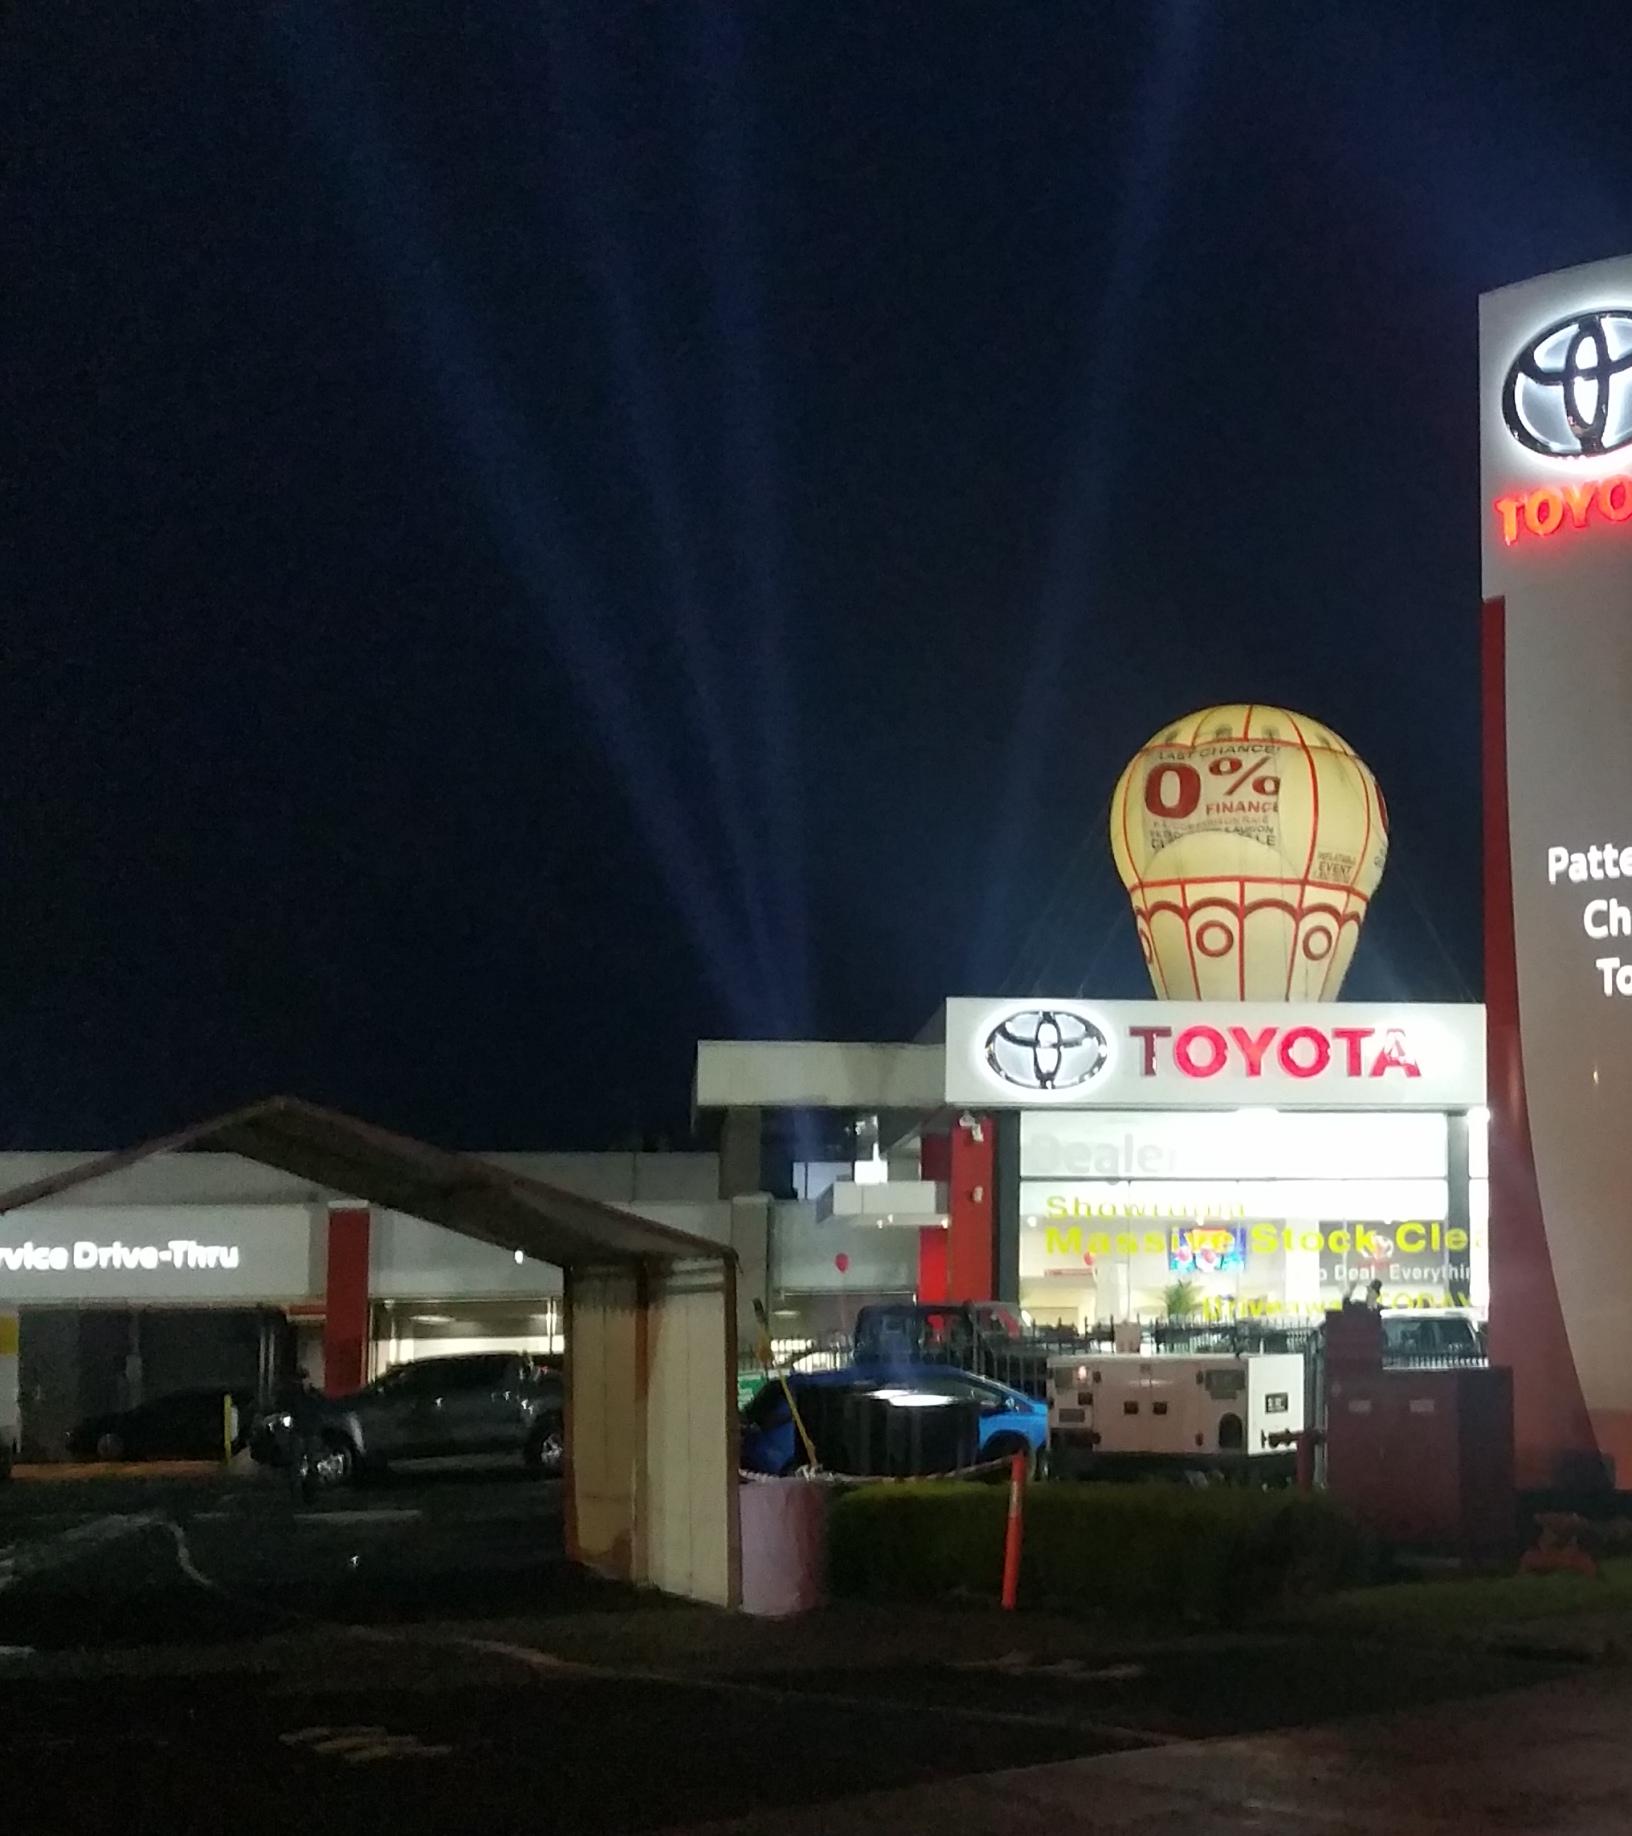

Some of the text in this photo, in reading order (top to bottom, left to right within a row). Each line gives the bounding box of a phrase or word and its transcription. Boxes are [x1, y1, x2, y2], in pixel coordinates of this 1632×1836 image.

[1144, 755, 1281, 819] 0%
[1206, 801, 1279, 815] FINANCE
[1129, 1025, 1422, 1079] TOYOTA
[73, 1240, 239, 1269] Drive-Thru
[1044, 1223, 1236, 1255] Massive
[1252, 1223, 1379, 1255] Stock
